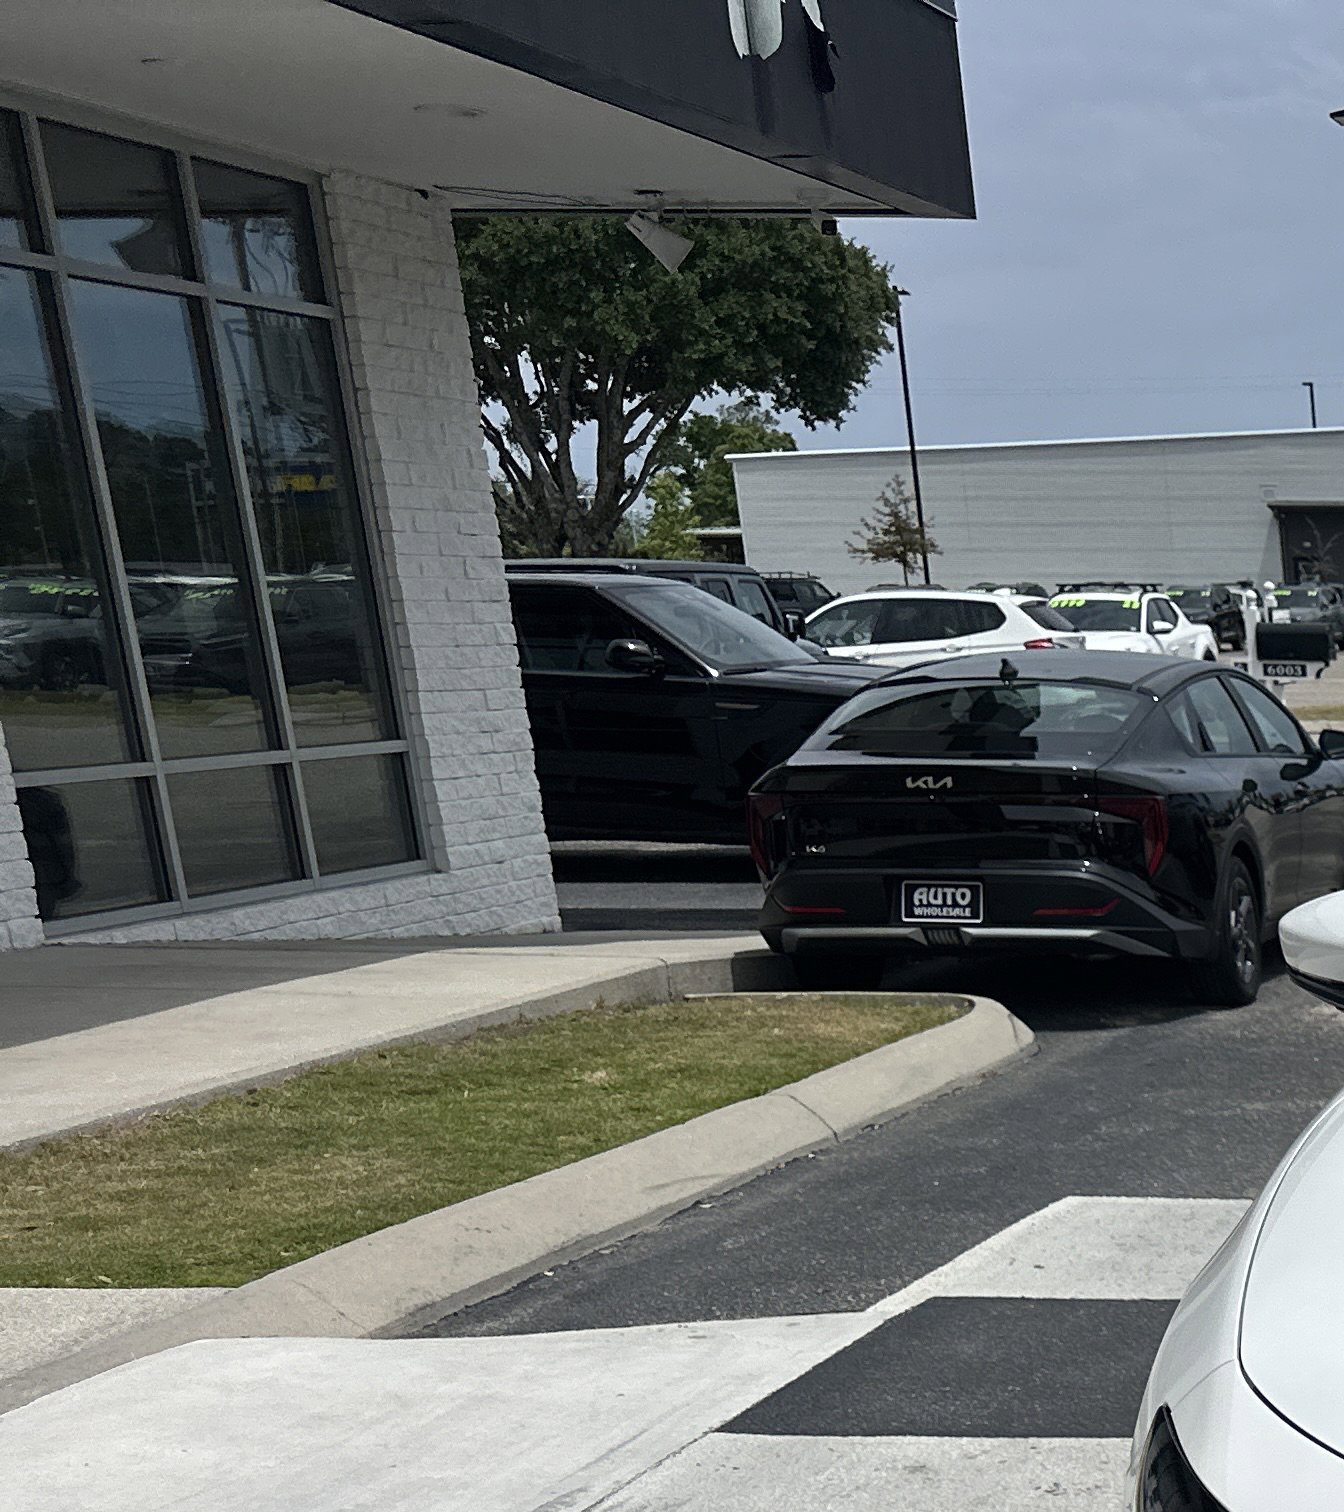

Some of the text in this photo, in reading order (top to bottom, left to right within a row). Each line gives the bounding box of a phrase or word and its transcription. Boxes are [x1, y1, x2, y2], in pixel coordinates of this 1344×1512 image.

[1266, 665, 1303, 676] 6003
[913, 887, 972, 906] AUTO
[913, 906, 972, 917] WHOLESALE
